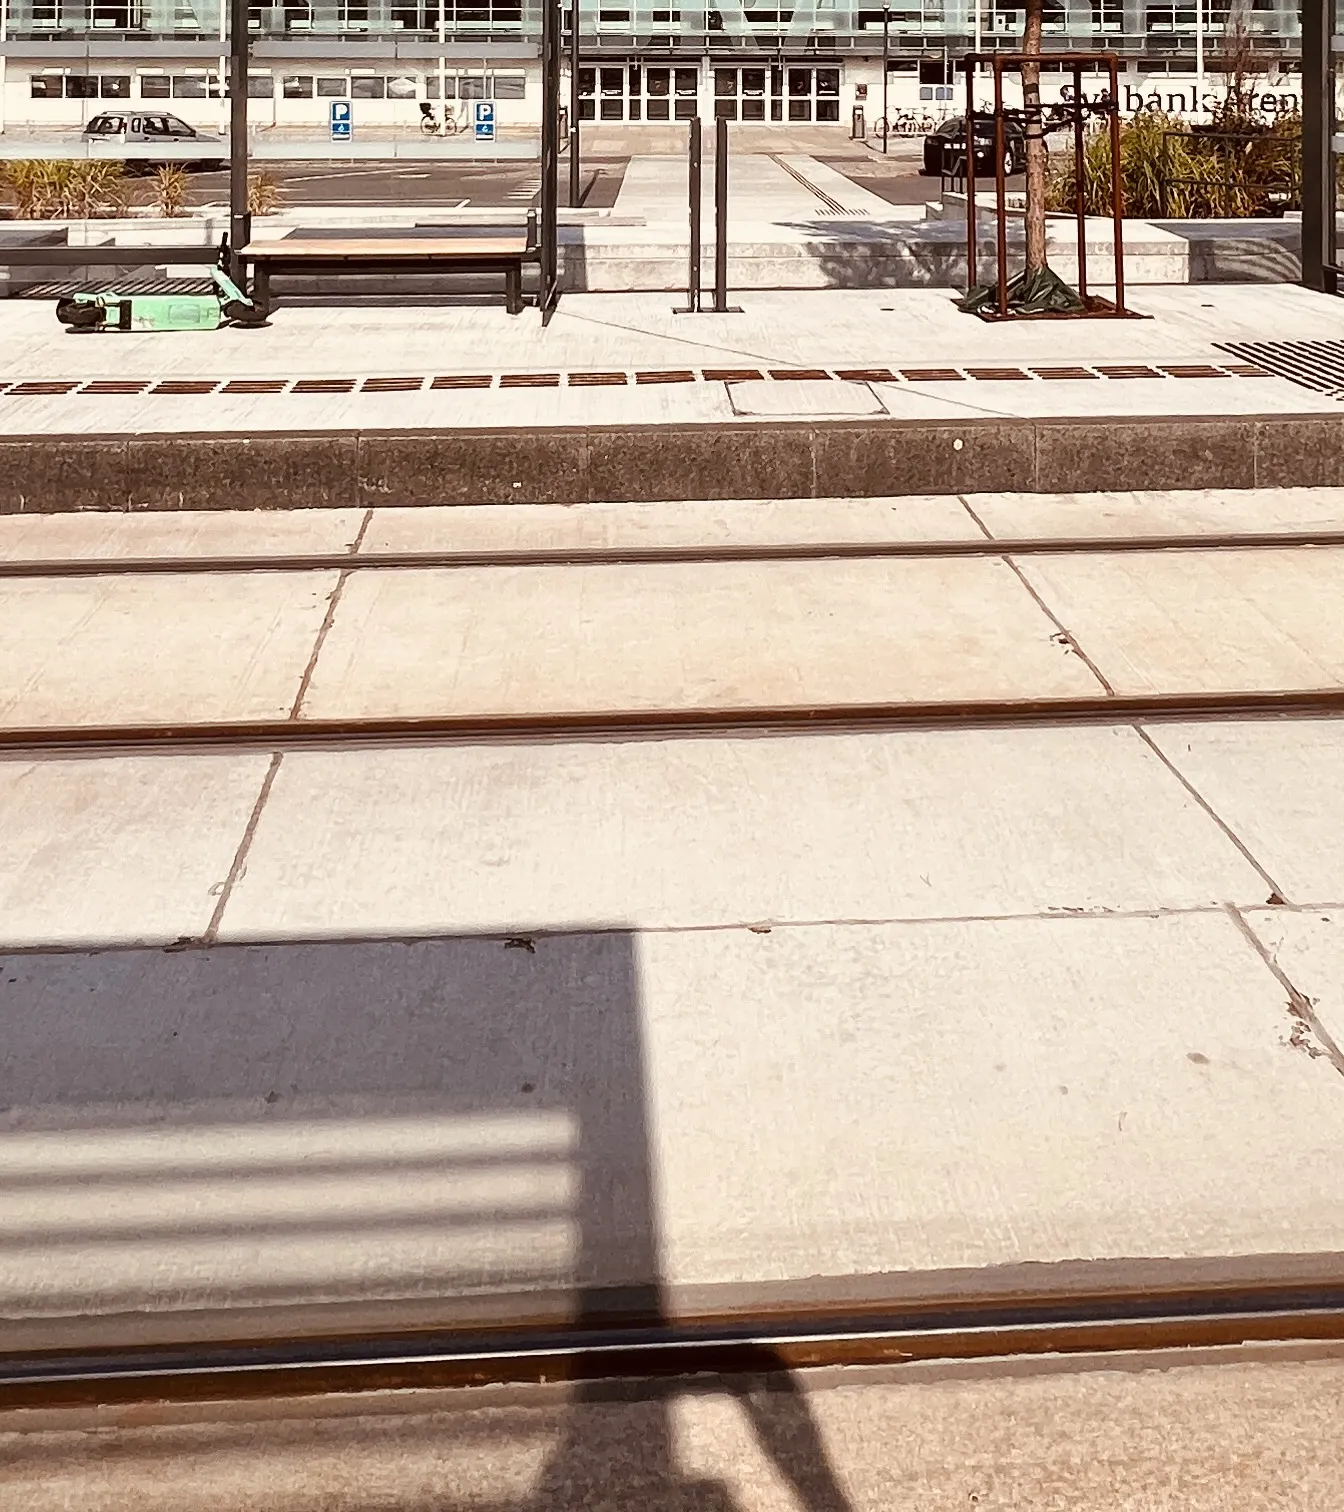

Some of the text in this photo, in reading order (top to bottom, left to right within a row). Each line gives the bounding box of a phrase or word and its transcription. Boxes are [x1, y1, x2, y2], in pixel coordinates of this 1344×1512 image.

[1059, 84, 1219, 116] Sybank
[335, 103, 349, 120] P
[478, 103, 492, 121] P
